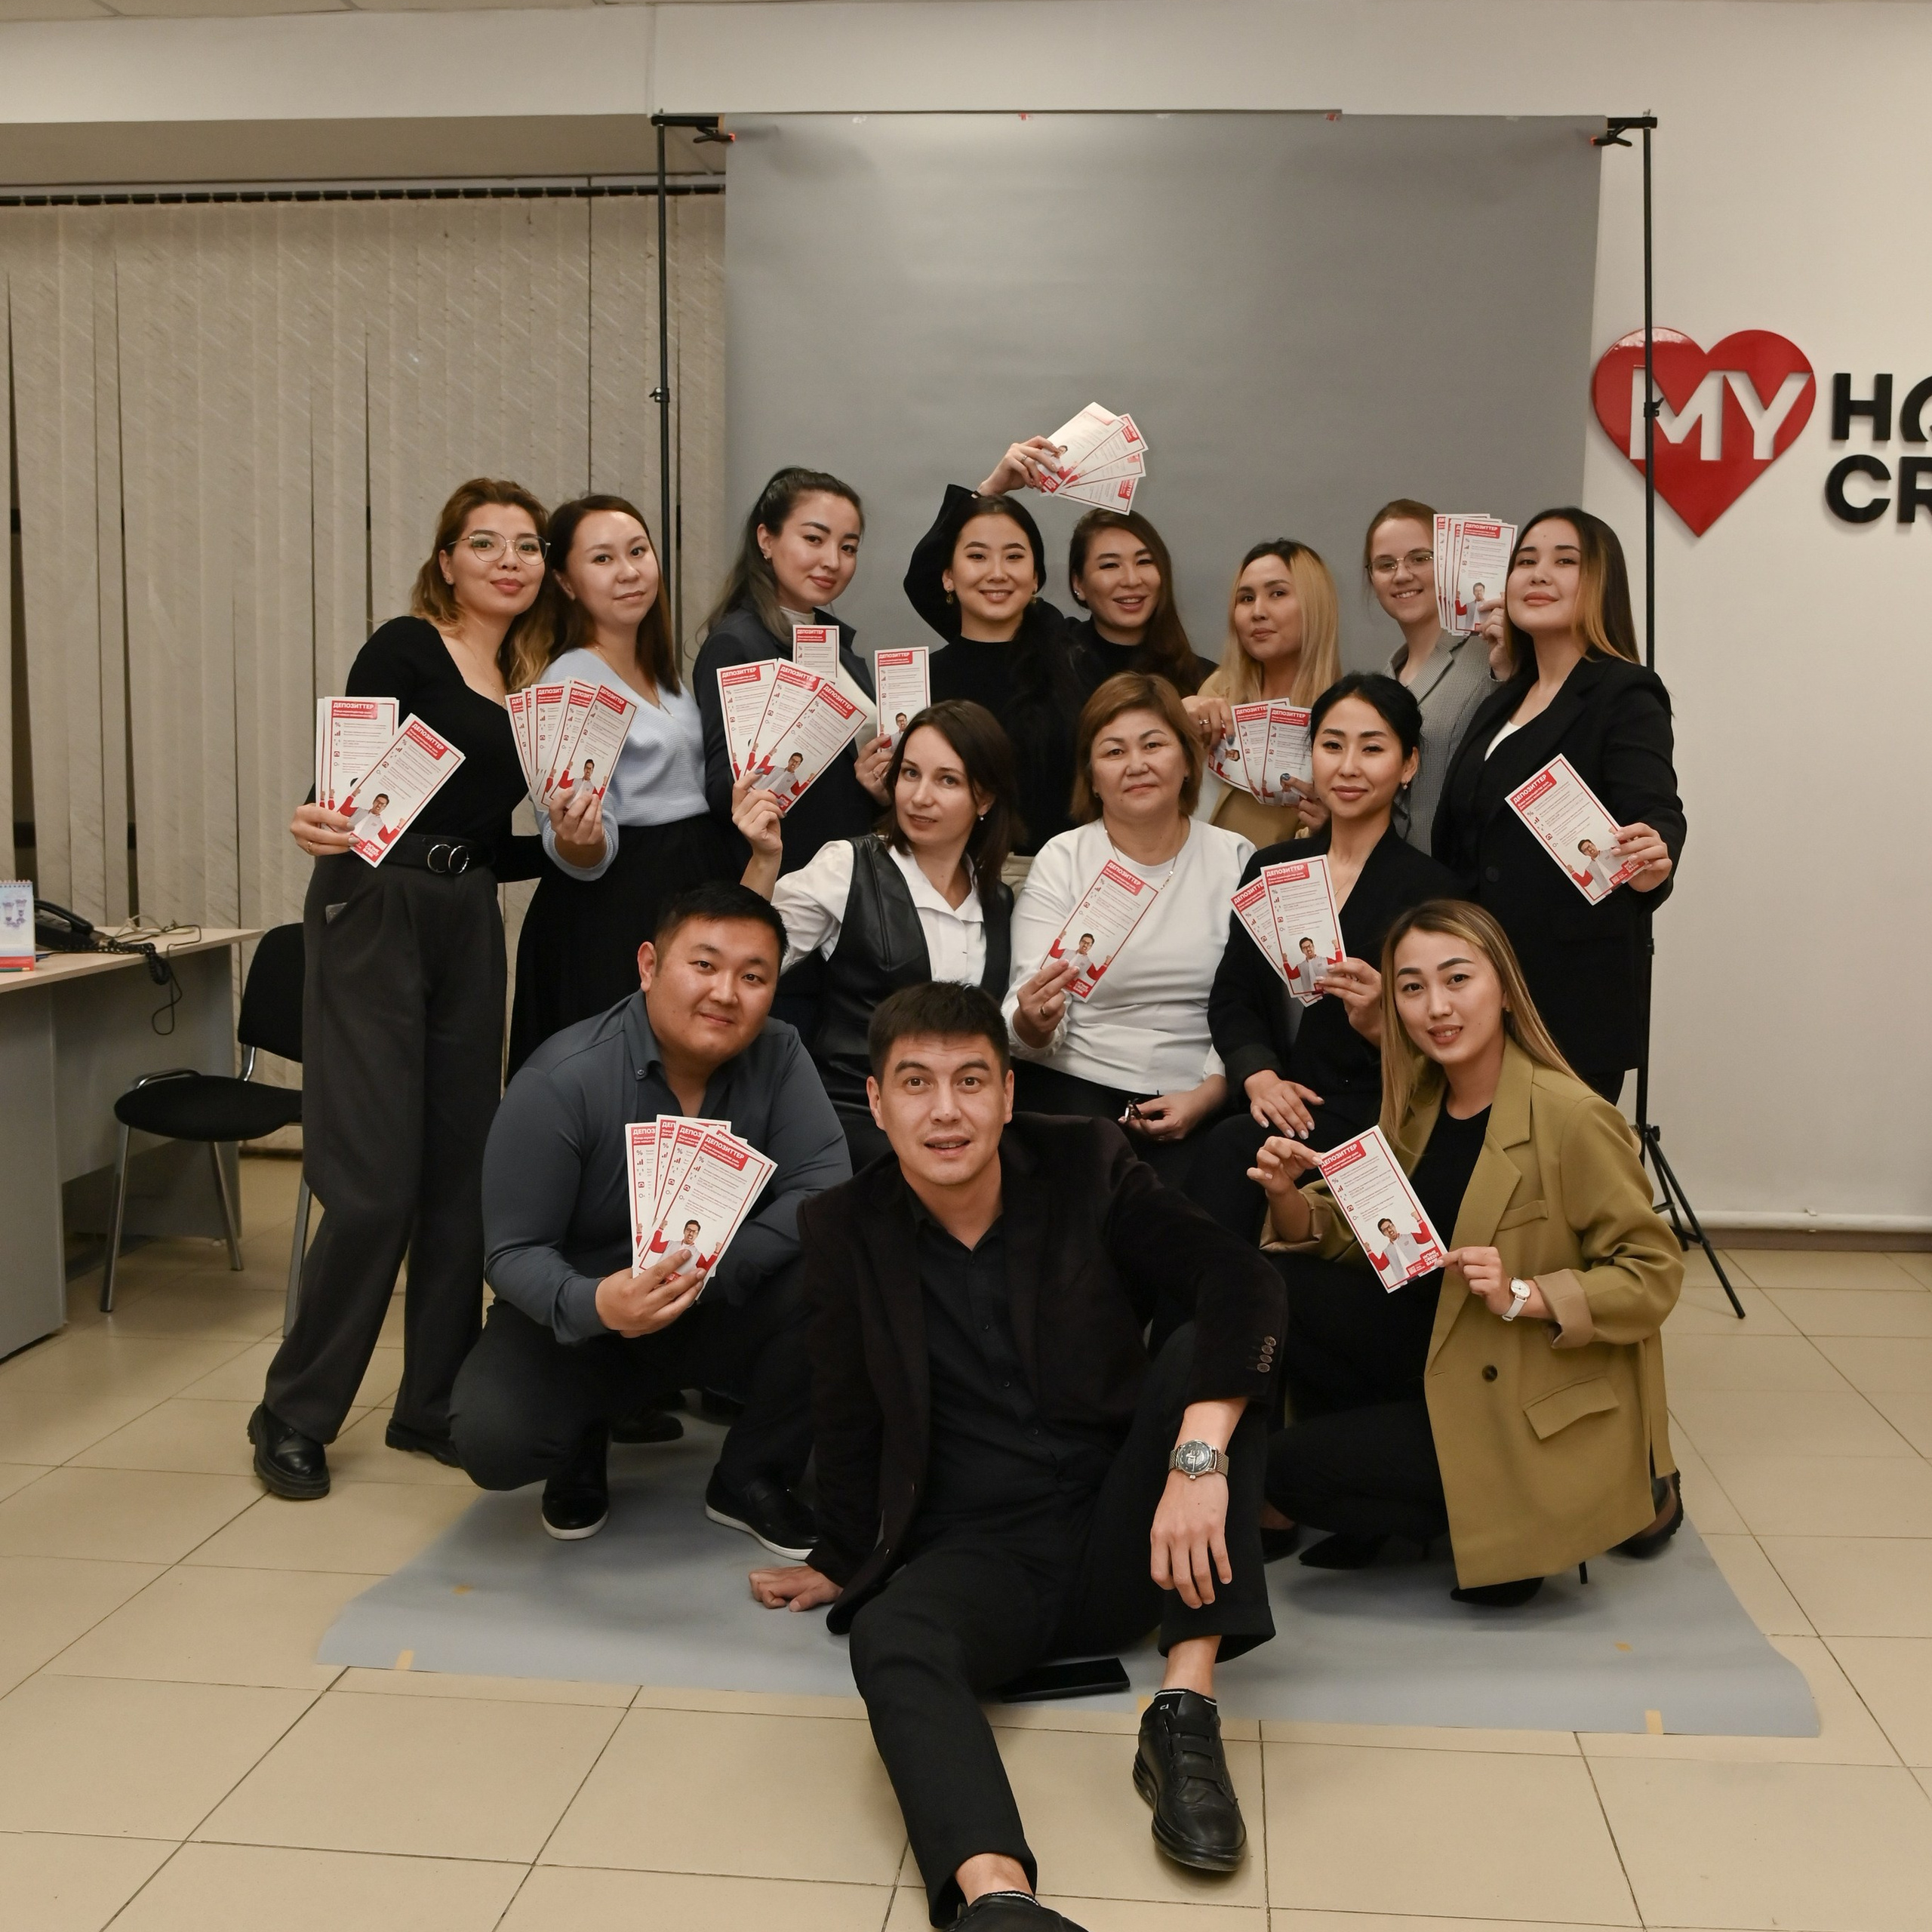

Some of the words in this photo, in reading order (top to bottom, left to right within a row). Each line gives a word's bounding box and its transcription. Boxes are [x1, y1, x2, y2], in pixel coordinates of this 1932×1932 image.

[1629, 365, 1813, 461] MY
[823, 685, 854, 710] ДЕПОЗИТТЕР
[411, 723, 445, 749] ДЕПОЗИТТЕР
[1513, 774, 1547, 804] ДЕПОЗИТТЕР
[1107, 862, 1142, 885] ДЕПОЗИТТЕР
[1266, 864, 1305, 878] ДЕПОЗИТТЕР
[704, 1137, 745, 1159] ДЕПОЗИТТЕР
[1321, 1143, 1358, 1168] ДЕПОЗИТТЕР
